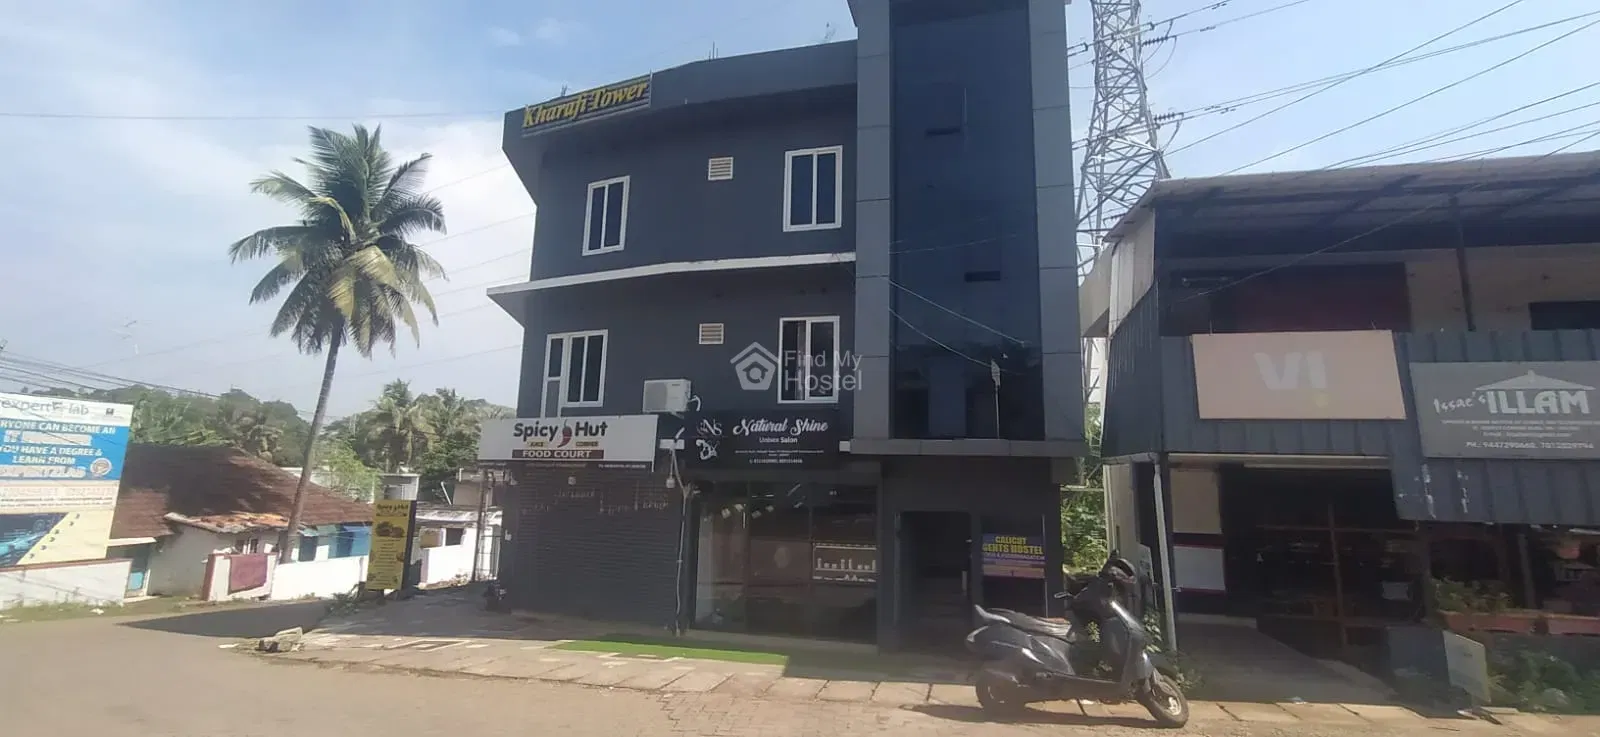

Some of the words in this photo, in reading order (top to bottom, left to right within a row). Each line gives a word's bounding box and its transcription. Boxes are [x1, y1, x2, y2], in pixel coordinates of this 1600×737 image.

[589, 82, 649, 110] Tower
[1487, 390, 1590, 414] ILLAM
[39, 422, 60, 431] CAN
[513, 422, 558, 441] Spicy
[575, 421, 608, 437] Hut
[732, 419, 788, 436] Natural
[789, 418, 828, 436] Shine
[21, 446, 48, 455] HAVE
[49, 447, 57, 455] A
[59, 448, 94, 457] DEGREE
[522, 450, 551, 458] FOOD
[554, 450, 592, 458] COURT
[48, 457, 76, 465] FROM
[995, 536, 1027, 544] CALICUT
[1010, 544, 1044, 554] HOSTEL
